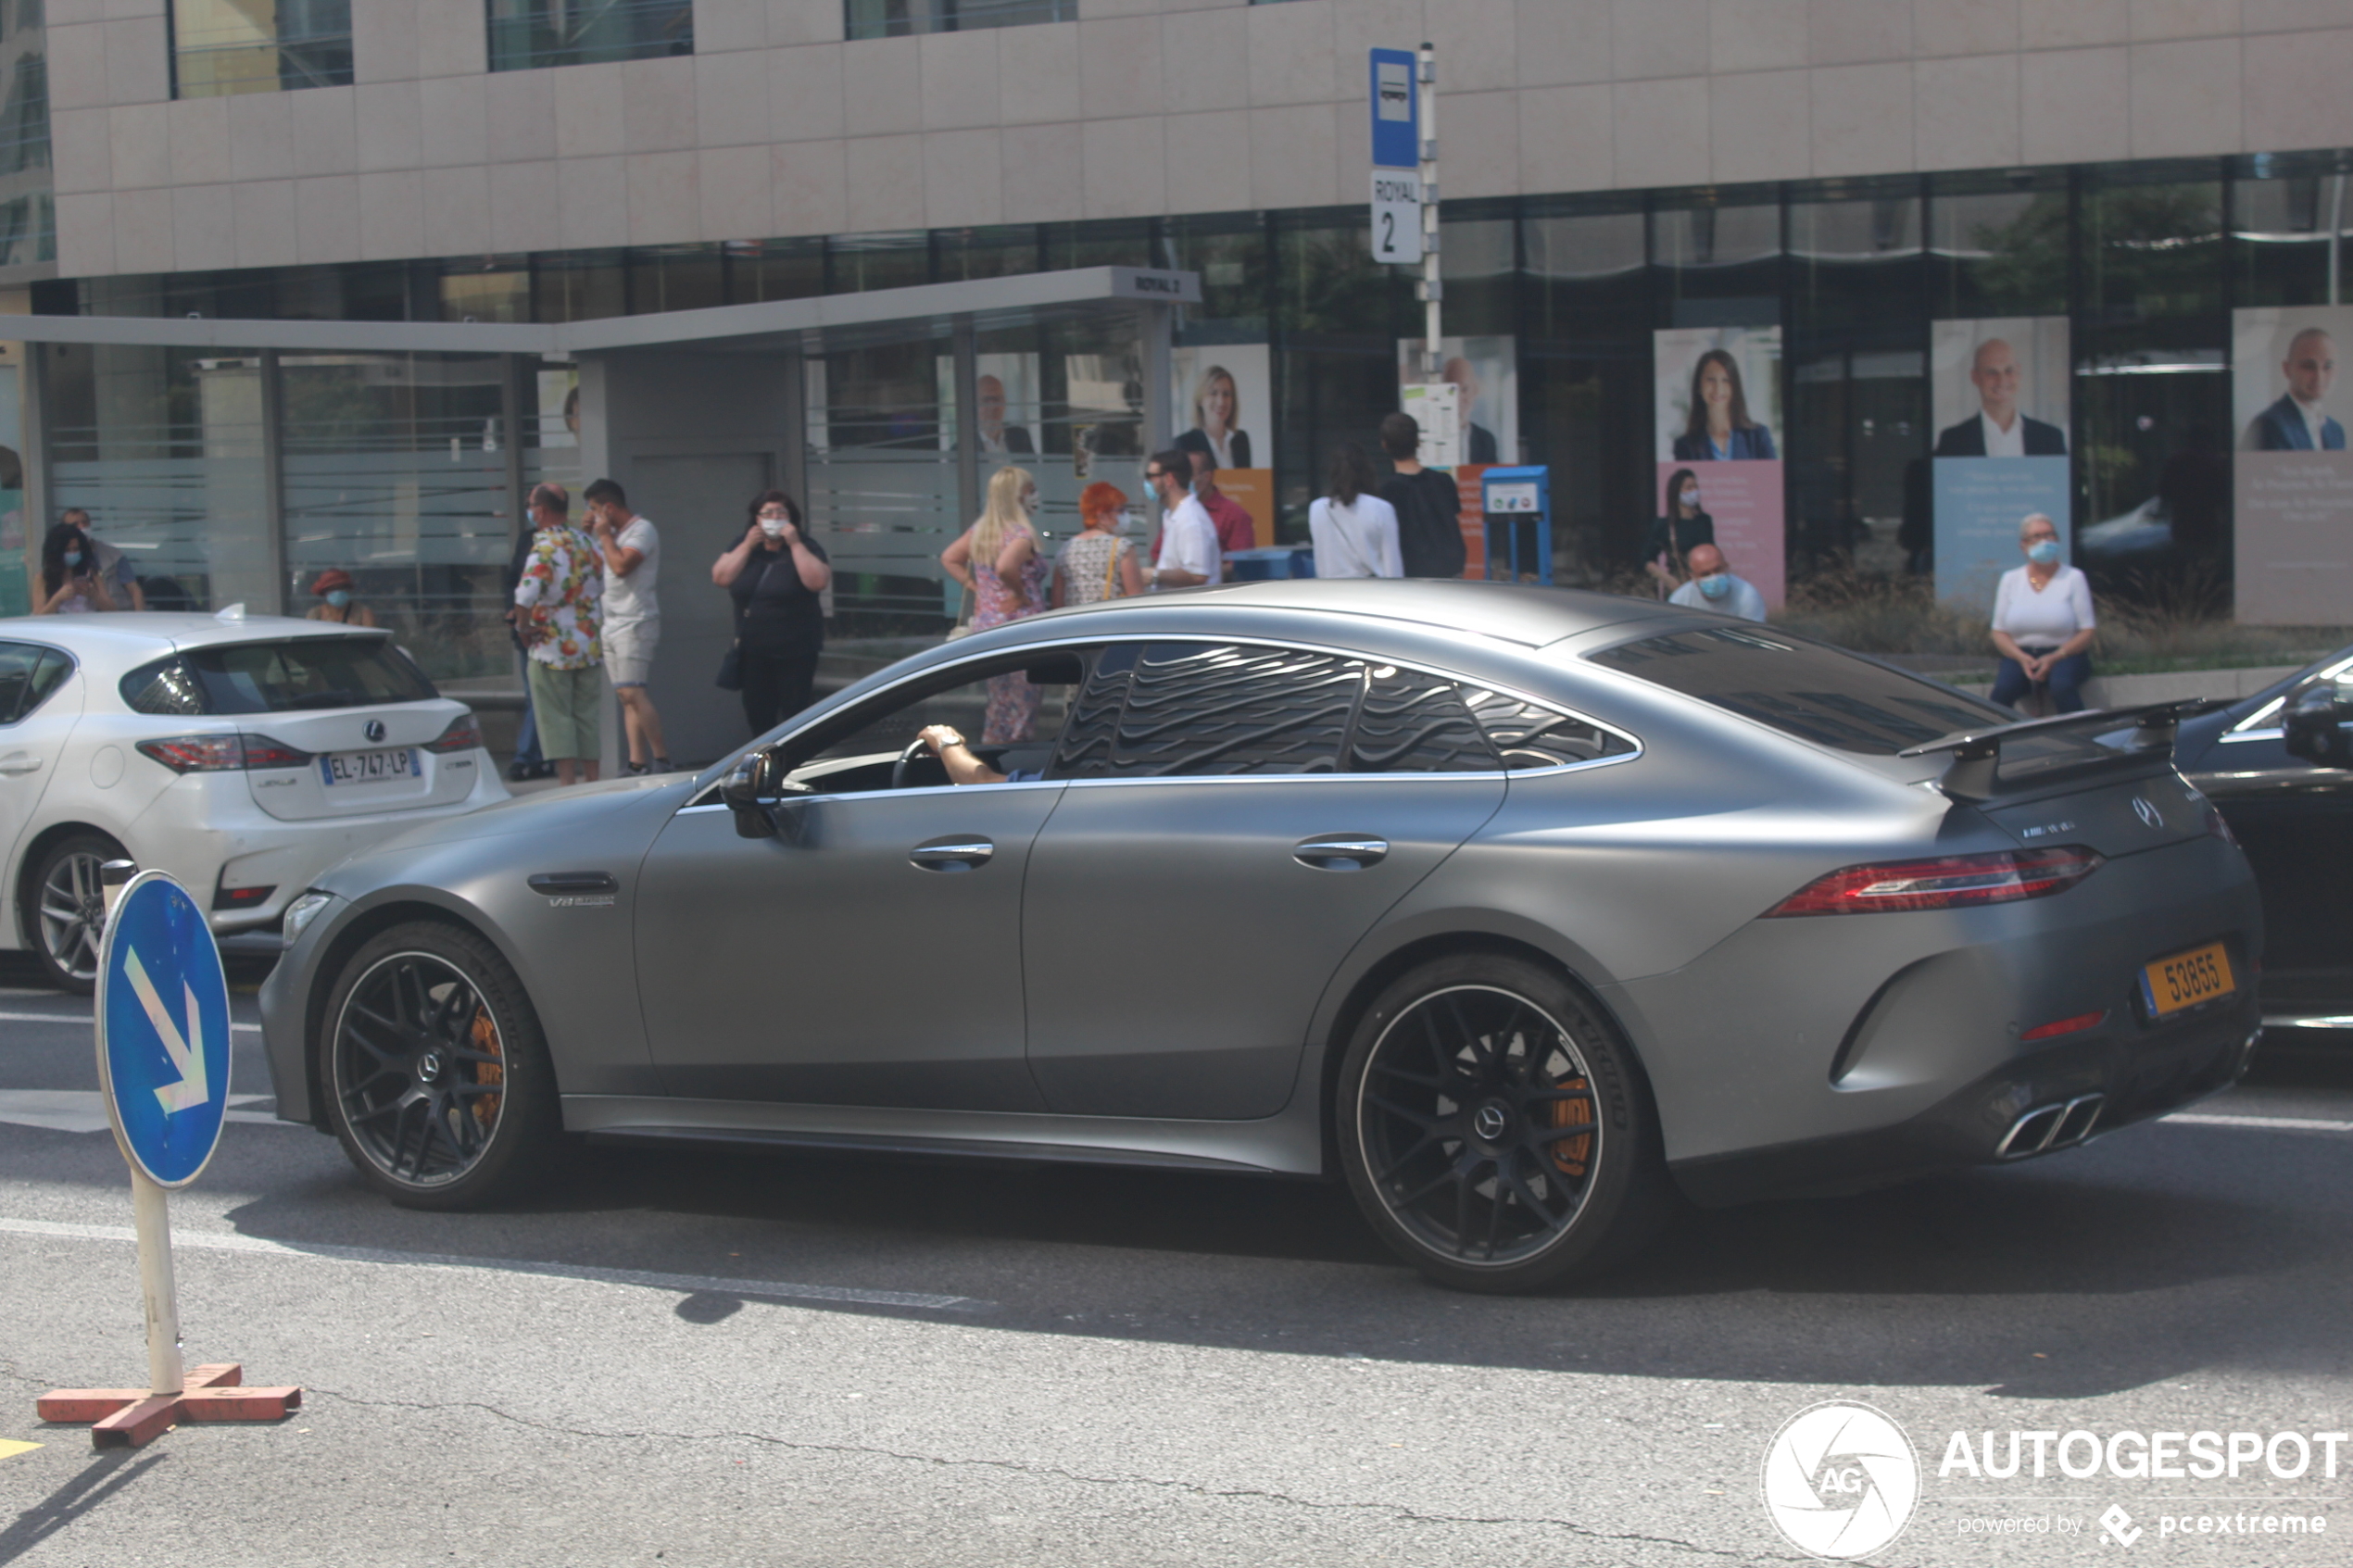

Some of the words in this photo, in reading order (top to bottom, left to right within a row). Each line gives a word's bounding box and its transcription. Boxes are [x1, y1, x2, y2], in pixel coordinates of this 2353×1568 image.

[1375, 180, 1417, 203] ROYAL
[1381, 211, 1395, 252] 2
[1135, 276, 1170, 292] ROYAL
[549, 897, 573, 908] V8
[2165, 952, 2221, 1002] 53855
